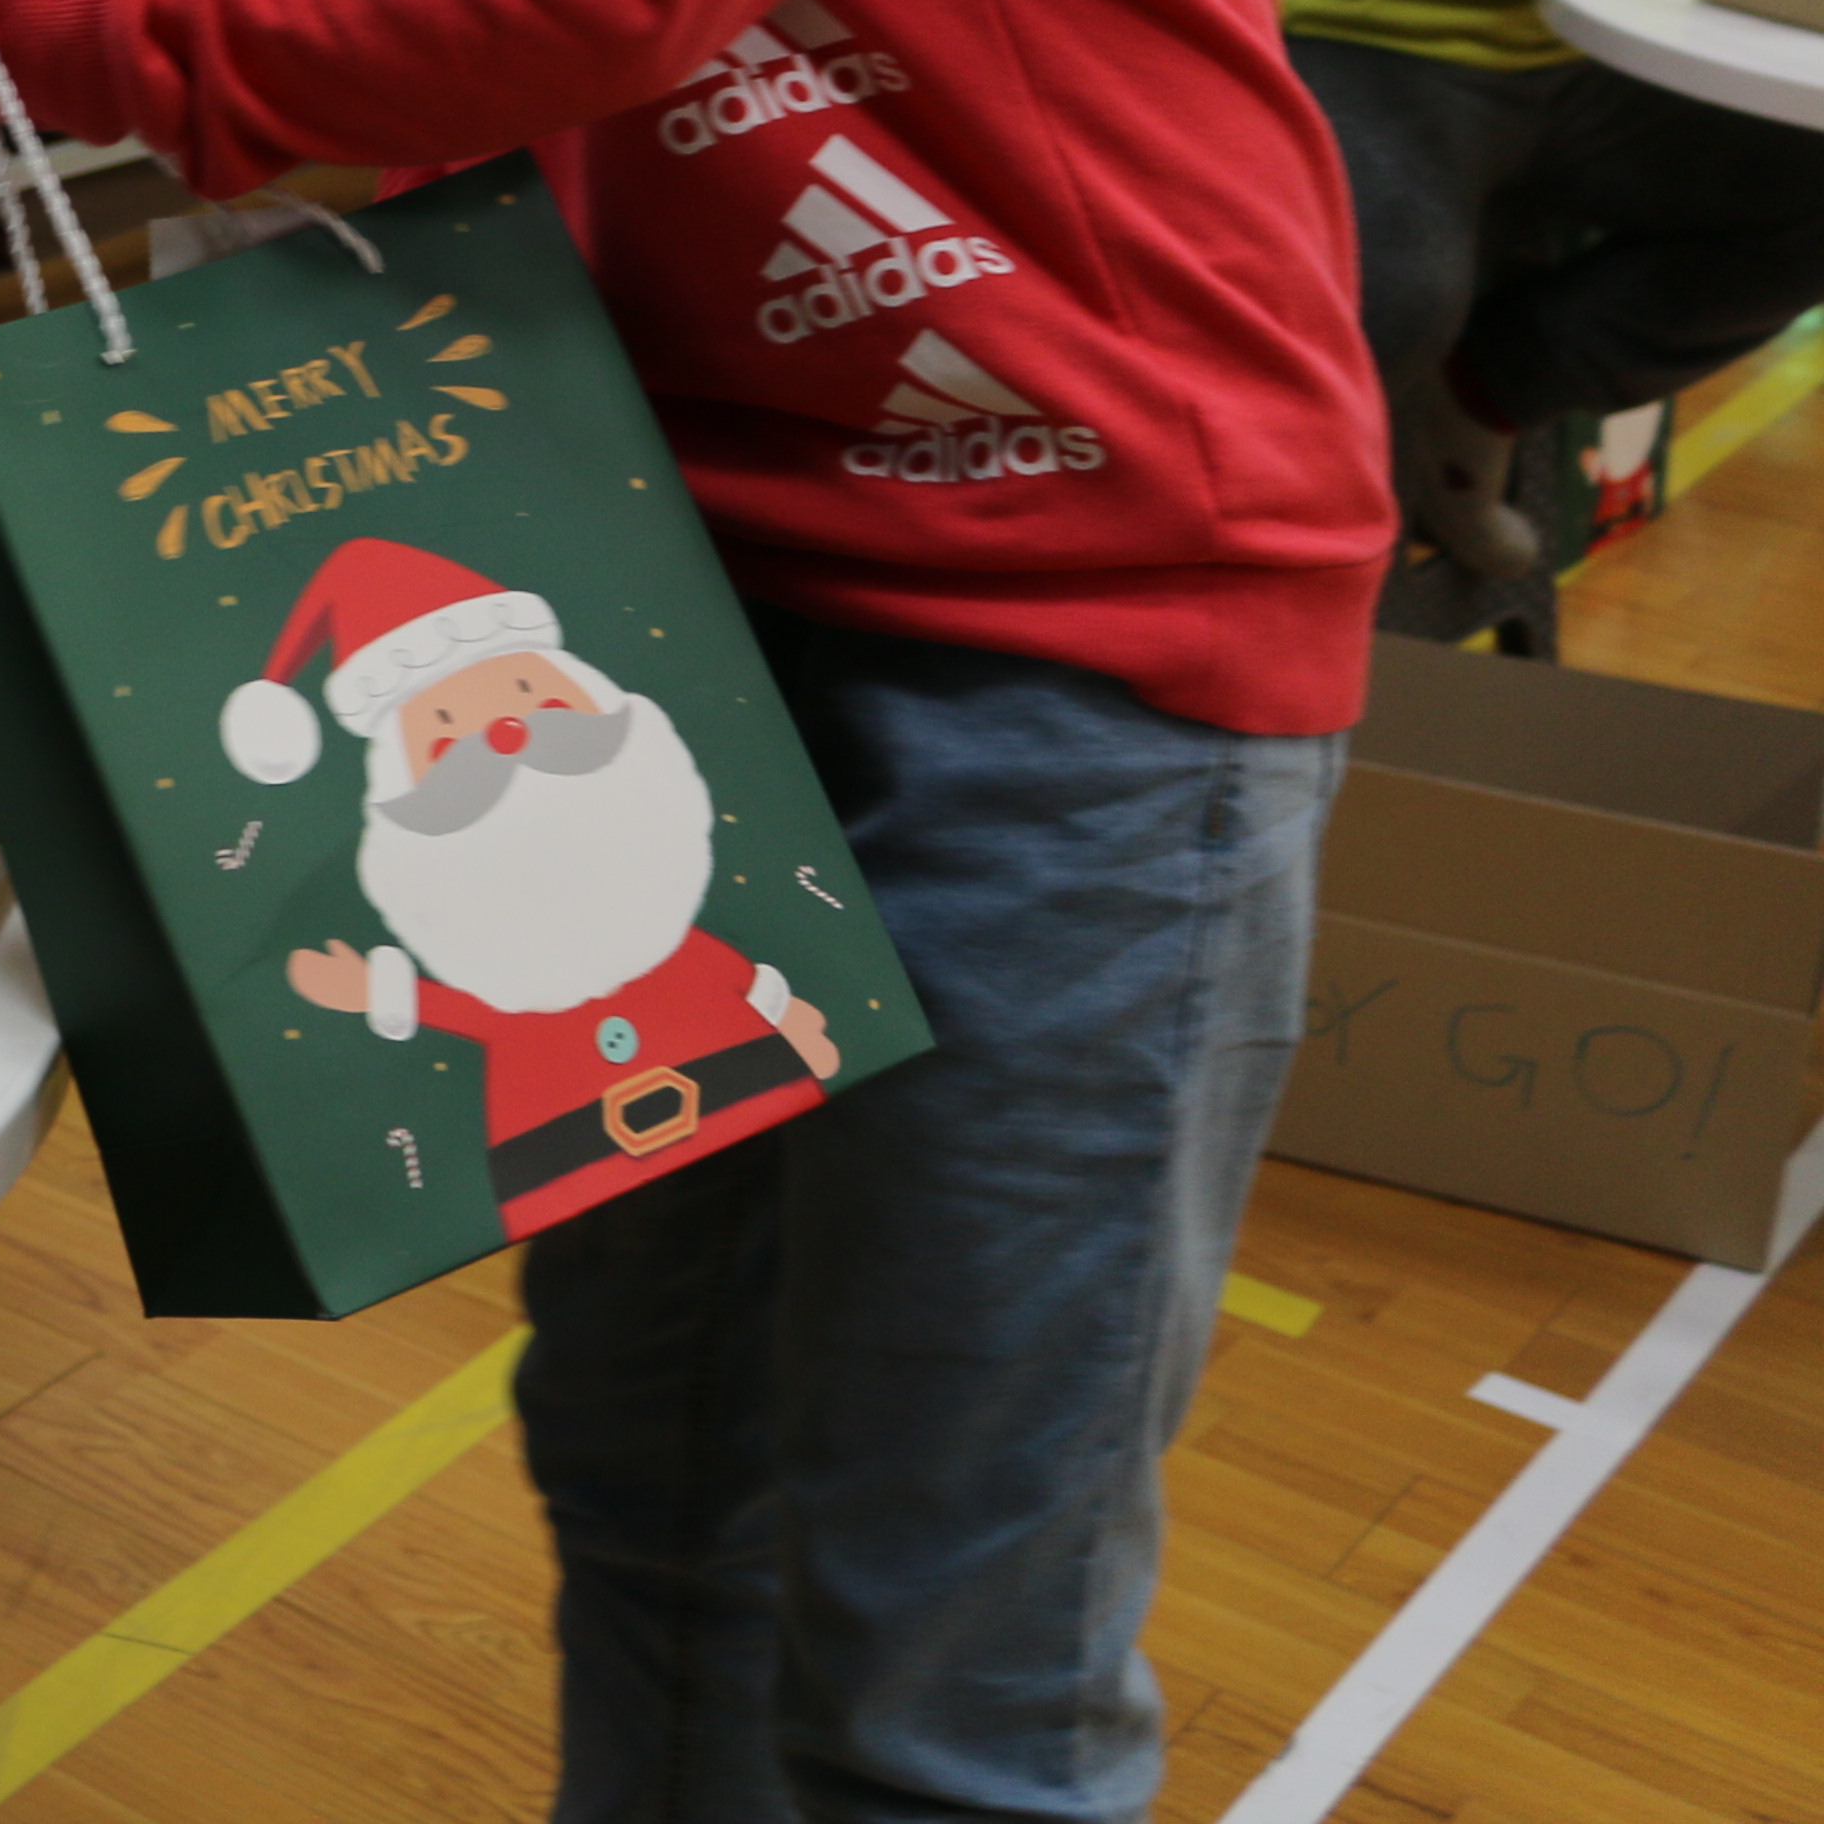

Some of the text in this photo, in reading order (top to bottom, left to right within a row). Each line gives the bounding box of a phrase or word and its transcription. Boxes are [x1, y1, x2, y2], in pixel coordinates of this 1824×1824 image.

[658, 50, 913, 156] adidas
[757, 237, 1017, 344] adidas
[206, 341, 381, 443] MERRY
[201, 414, 469, 549] CHRISTMAS
[841, 416, 1108, 482] adidas
[1447, 1004, 1737, 1161] GO!
